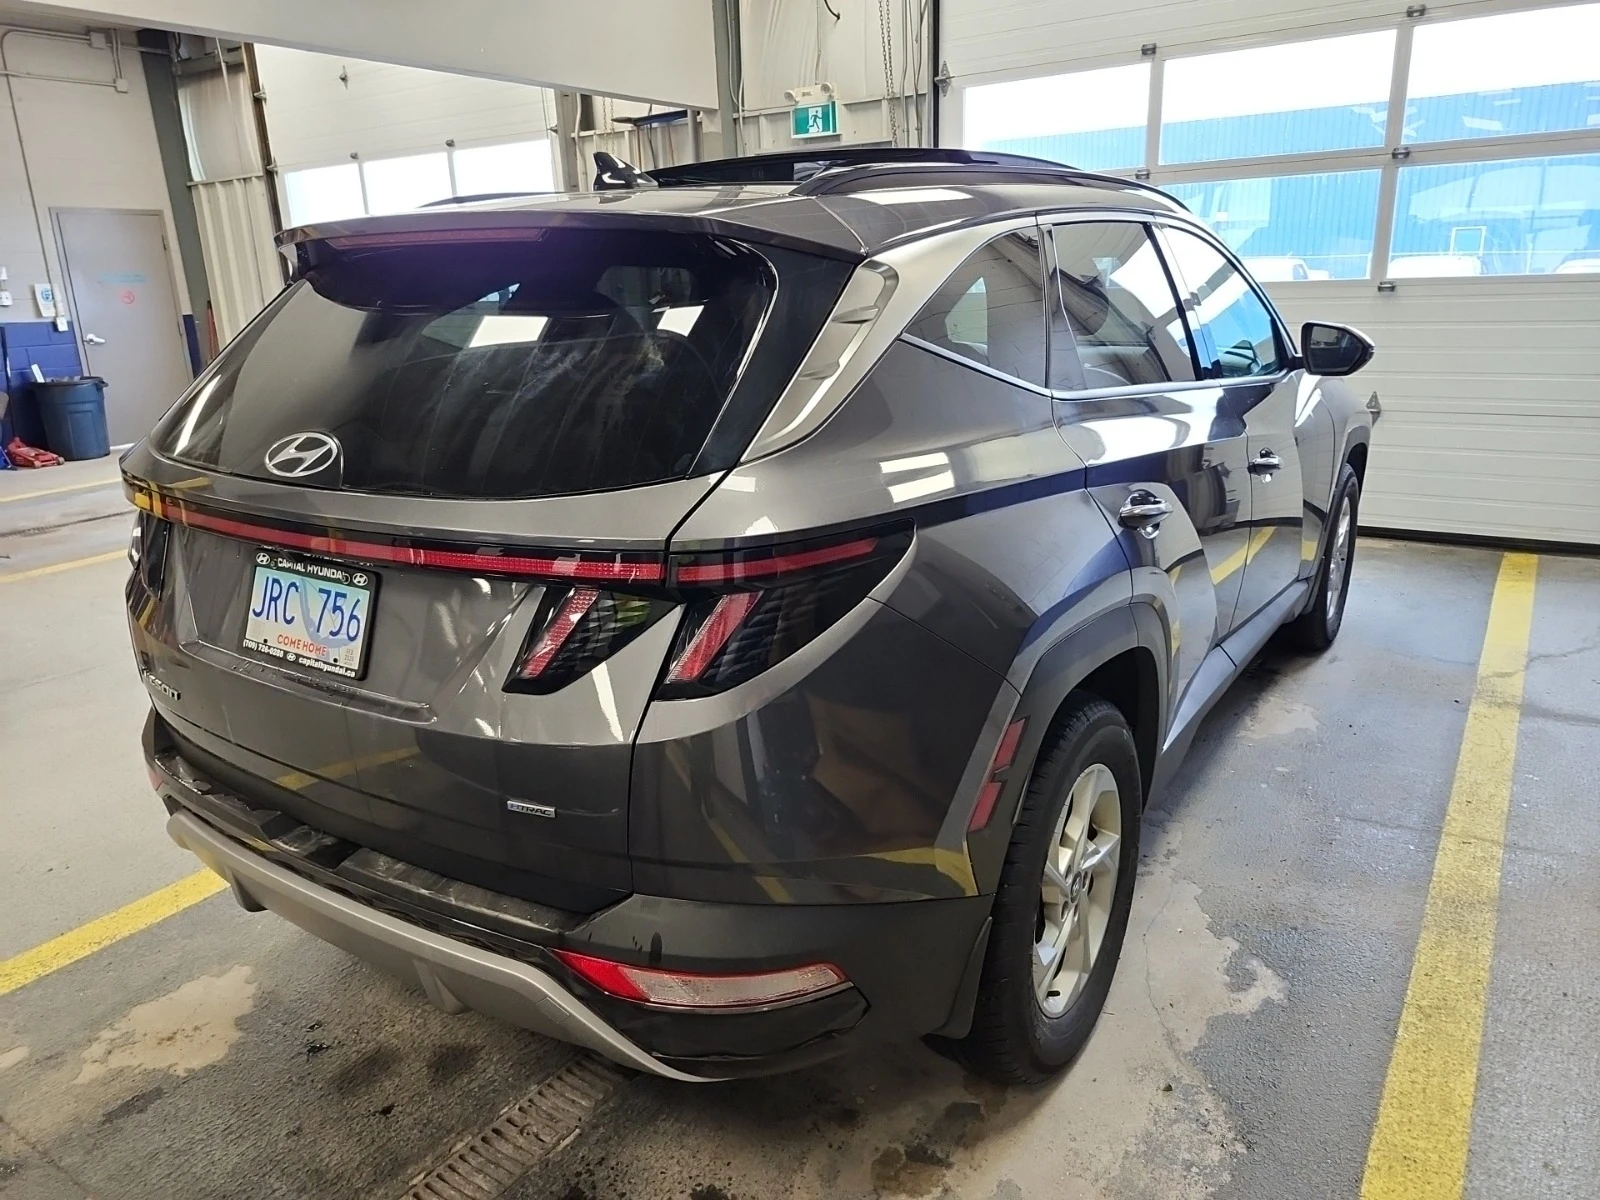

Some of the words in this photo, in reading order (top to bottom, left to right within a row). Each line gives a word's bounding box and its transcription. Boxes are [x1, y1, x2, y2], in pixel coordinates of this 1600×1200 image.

[277, 557, 306, 572] CAPITAL
[252, 576, 300, 625] JRC
[317, 587, 361, 642] 756
[277, 634, 301, 650] COME
[302, 641, 327, 656] HOME
[298, 657, 356, 678] capitalhyundai.ca
